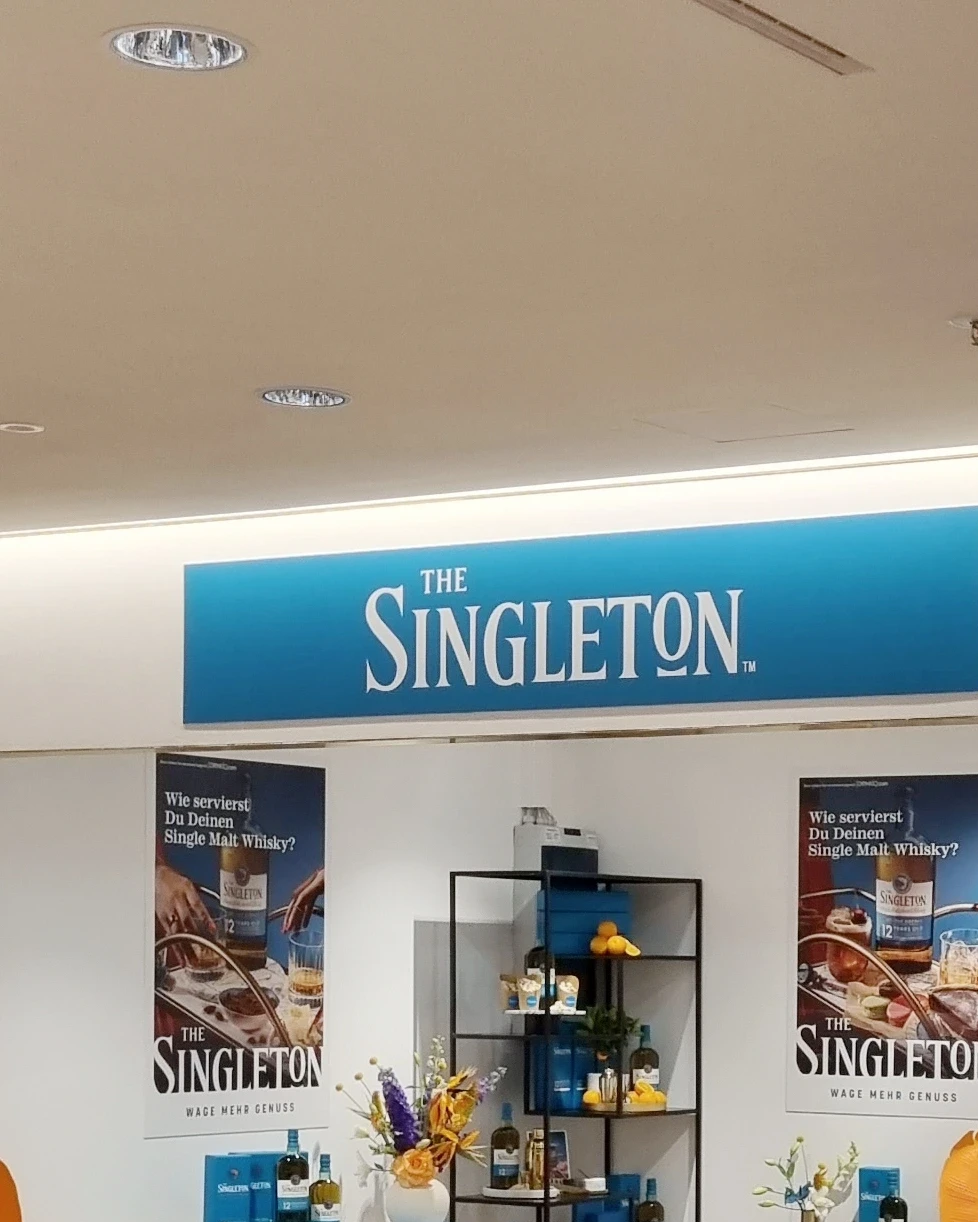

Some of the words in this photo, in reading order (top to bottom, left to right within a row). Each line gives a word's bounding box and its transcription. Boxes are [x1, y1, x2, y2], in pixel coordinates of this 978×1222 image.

[420, 567, 468, 594] THE
[365, 584, 744, 694] SINGLETON
[165, 791, 191, 808] Wie
[193, 795, 250, 812] servierst
[165, 810, 184, 826] Du
[188, 812, 234, 829] Deinen
[809, 810, 835, 824] Wie
[839, 809, 904, 823] servierst
[164, 829, 206, 849] Single
[209, 831, 239, 848] Malt
[242, 834, 296, 853] Whisky?
[809, 827, 829, 840] Du
[834, 826, 885, 840] Deinen
[808, 843, 853, 860] Single
[856, 843, 890, 857] Malt
[894, 842, 959, 859] Whisky?
[881, 890, 926, 906] SINGLETON
[224, 919, 235, 933] 12
[882, 923, 893, 939] 12
[825, 1017, 852, 1031] THE
[181, 1027, 206, 1042] THE
[153, 1035, 323, 1094] SINGLETON
[830, 1088, 863, 1099] WAGE
[870, 1090, 902, 1100] MEHR
[909, 1092, 957, 1102] GENUSS
[186, 1106, 216, 1117] WAGE
[221, 1104, 249, 1115] MEHR
[255, 1102, 295, 1113] GENUSS
